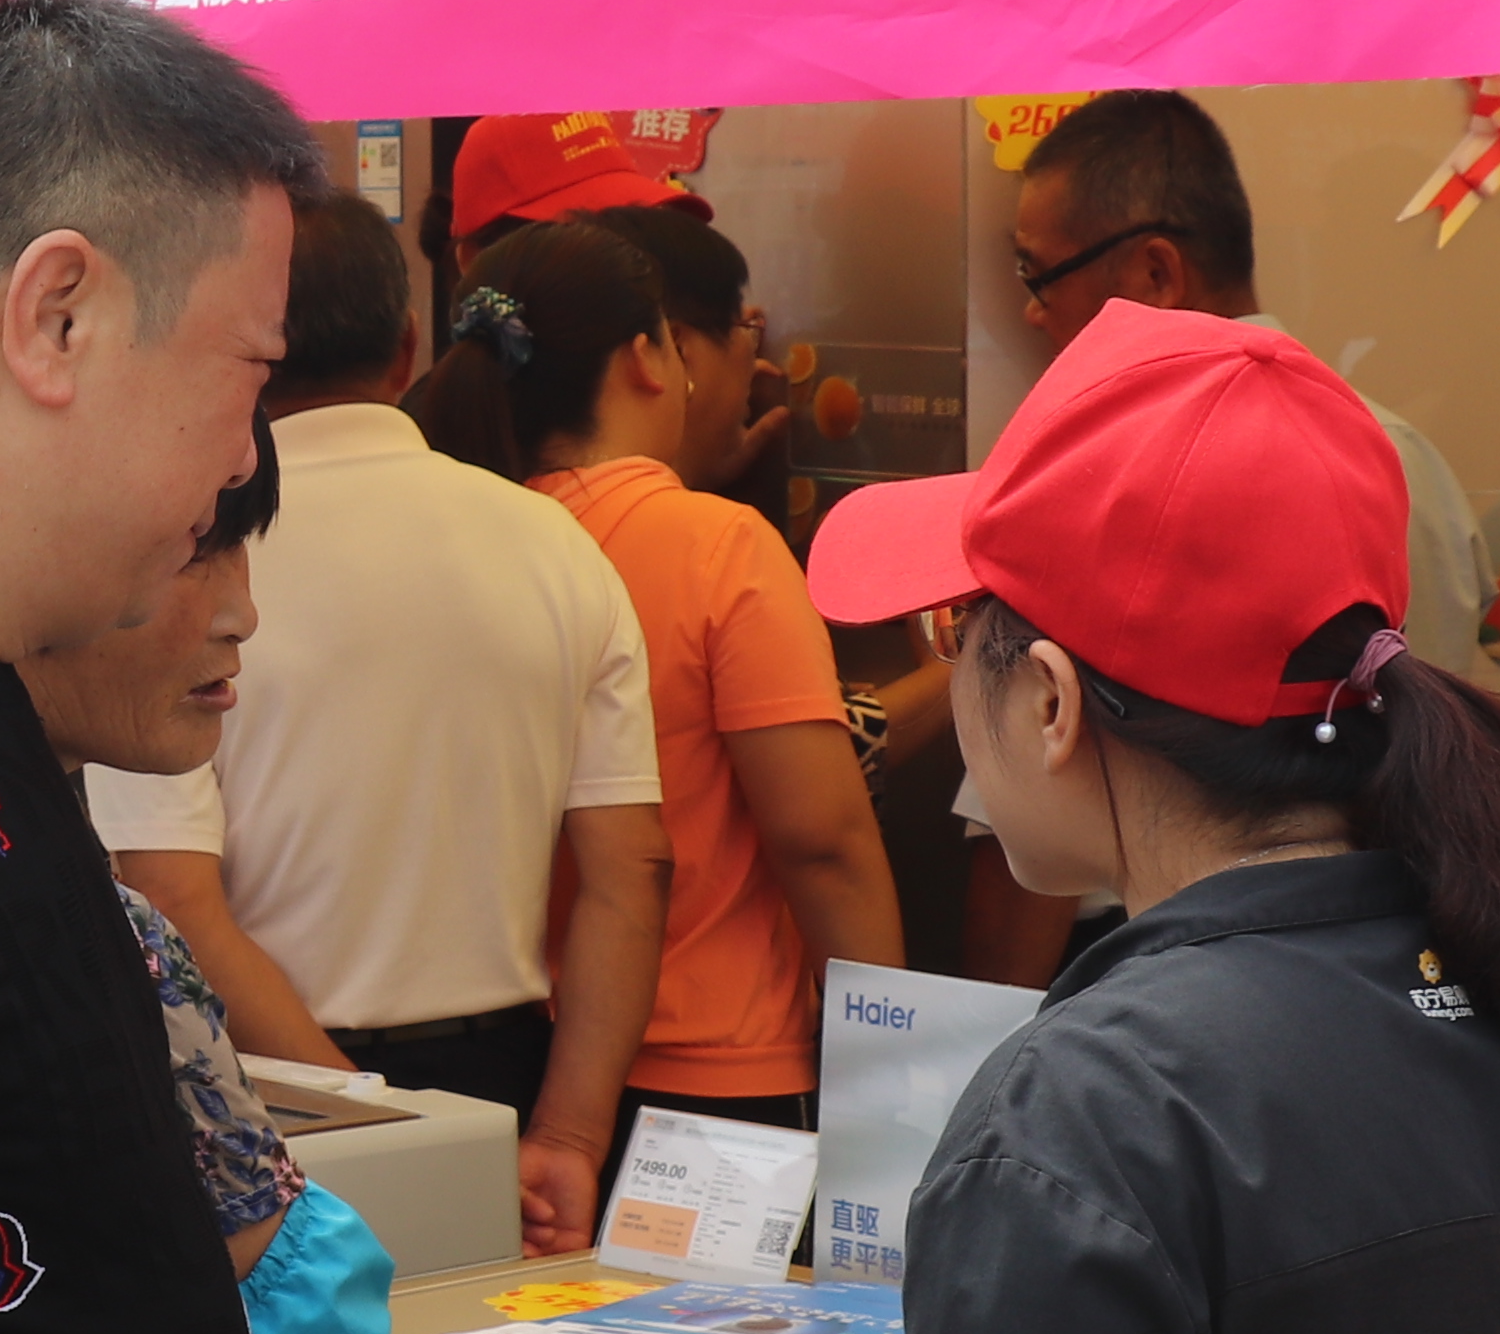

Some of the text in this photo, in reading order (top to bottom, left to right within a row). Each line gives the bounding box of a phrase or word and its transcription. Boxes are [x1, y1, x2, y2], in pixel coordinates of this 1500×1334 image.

[844, 991, 917, 1032] Haier
[632, 1157, 689, 1180] 7499.00
[831, 1198, 880, 1237] 直驱
[830, 1236, 905, 1280] 更平稳
